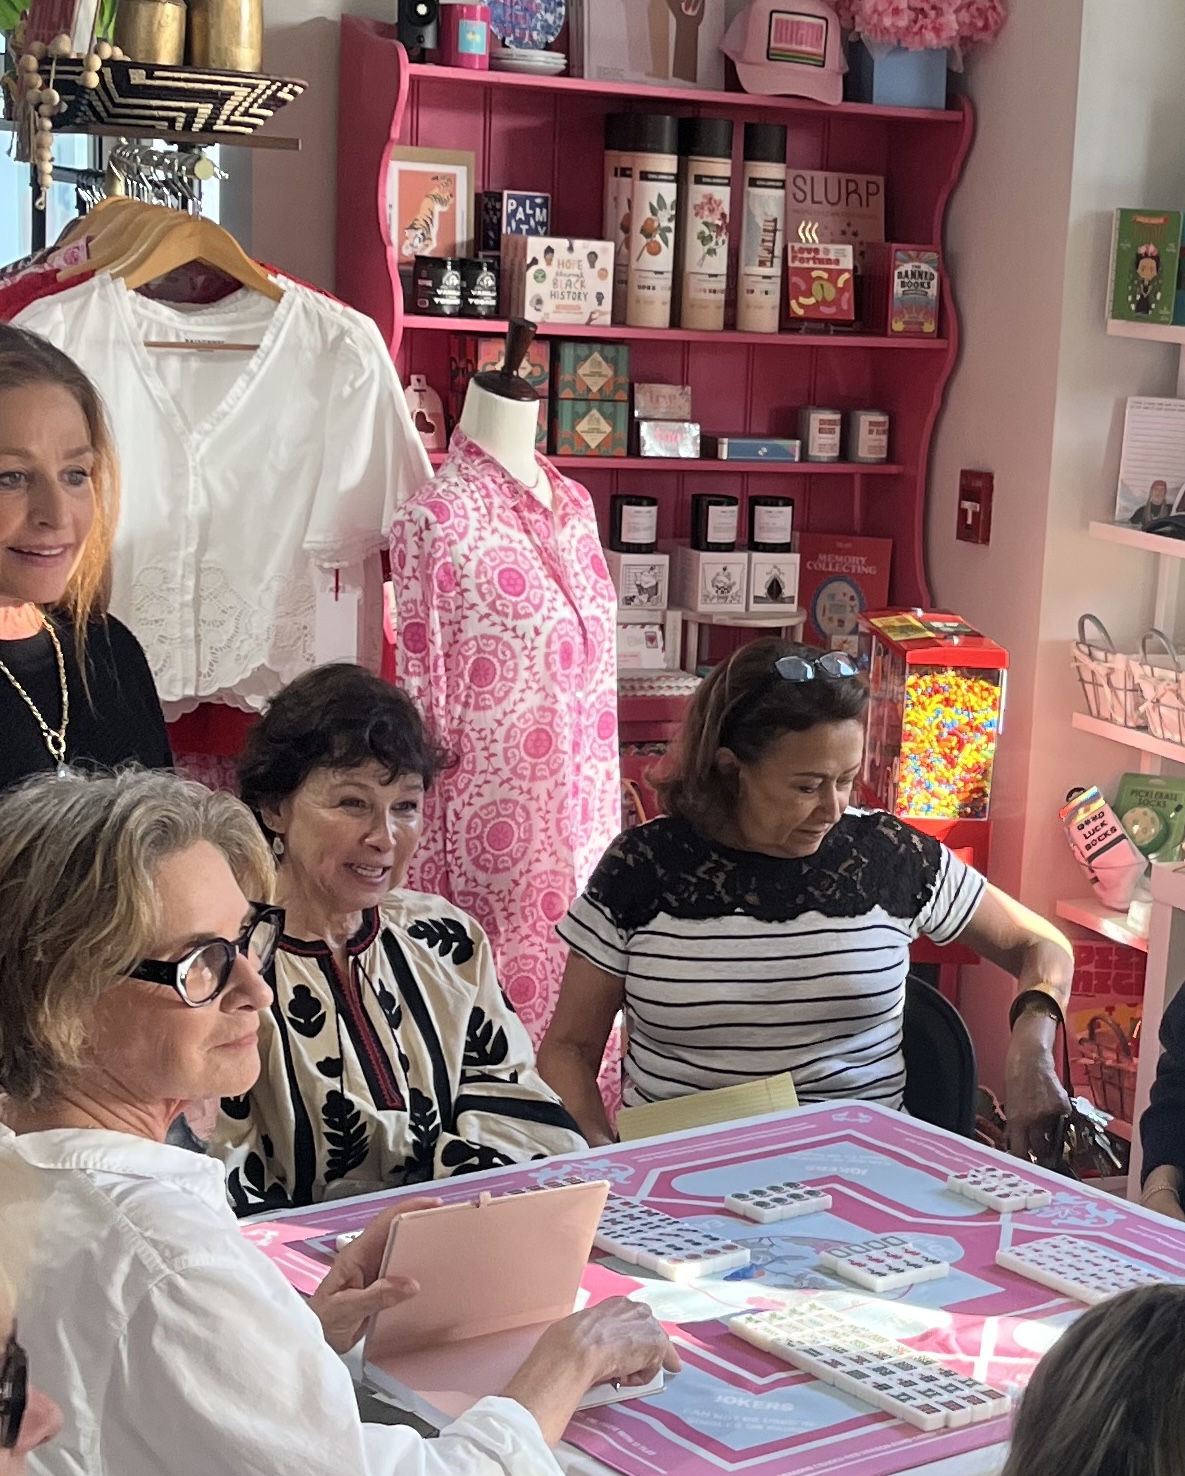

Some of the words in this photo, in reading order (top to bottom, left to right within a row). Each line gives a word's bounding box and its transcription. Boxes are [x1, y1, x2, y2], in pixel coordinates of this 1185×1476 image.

[792, 174, 880, 208] SLURP
[507, 198, 547, 223] PALM
[897, 270, 935, 282] BANNED
[552, 279, 586, 290] BLACK
[900, 280, 932, 290] BOOKS
[549, 290, 588, 302] HISTORY
[818, 553, 868, 566] MEMORY
[806, 562, 877, 575] COLLECTING
[1130, 789, 1179, 802] PICKLEBALL
[1138, 799, 1167, 808] SOCKS
[1083, 820, 1109, 840] LUCK
[1085, 826, 1117, 851] SOCKS
[715, 1395, 795, 1413] JOKERS
